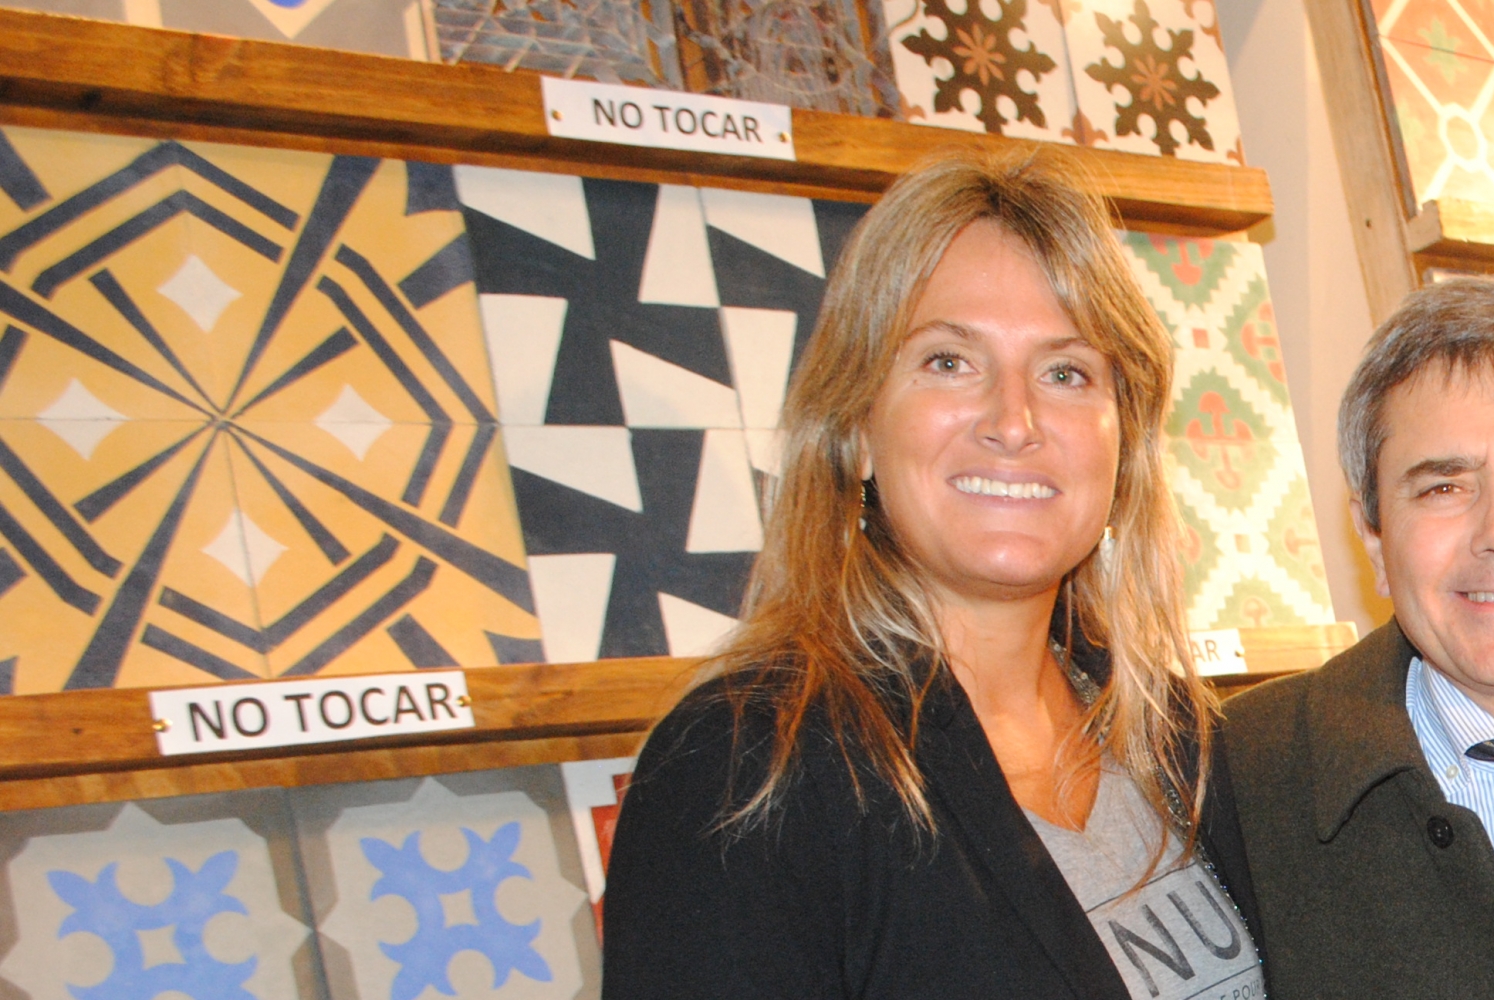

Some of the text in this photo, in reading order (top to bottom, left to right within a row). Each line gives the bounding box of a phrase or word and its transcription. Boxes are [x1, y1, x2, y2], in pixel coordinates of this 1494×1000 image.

[592, 98, 764, 144] NO TOCAR
[187, 682, 459, 742] NO TOCAR
[1107, 880, 1243, 998] NU
